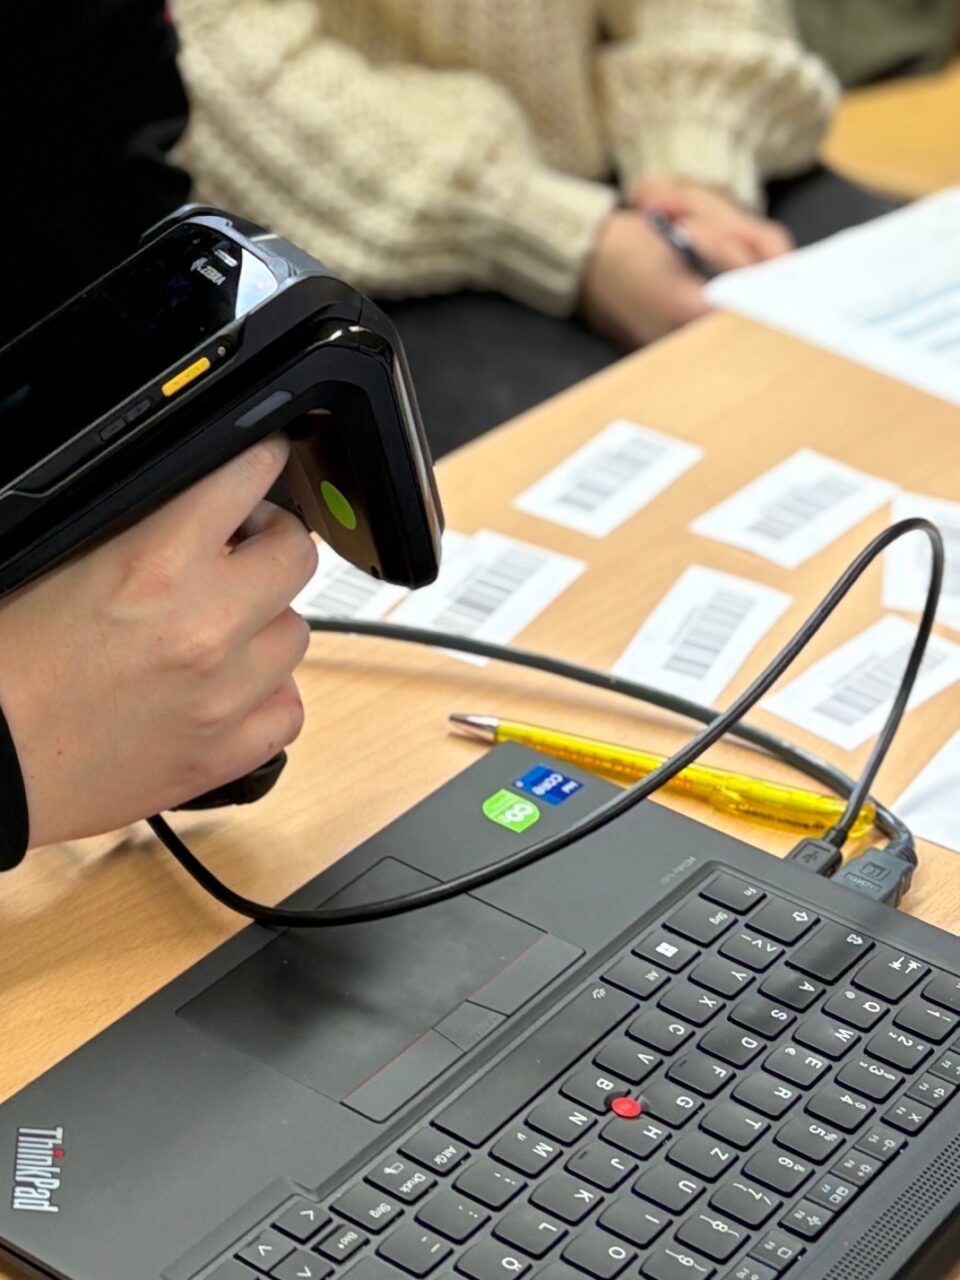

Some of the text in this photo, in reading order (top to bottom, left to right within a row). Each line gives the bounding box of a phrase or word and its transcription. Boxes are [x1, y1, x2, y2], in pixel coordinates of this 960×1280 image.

[200, 265, 227, 286] ZEBRA
[533, 971, 747, 1157] Y X C V B N M
[502, 981, 814, 1271] A S D F G H J K L Ö
[609, 1002, 880, 1259] Q W E R T Z U I O
[13, 1127, 64, 1212] ThinkPad
[369, 1203, 391, 1218] Strg
[399, 1173, 426, 1193] Druck
